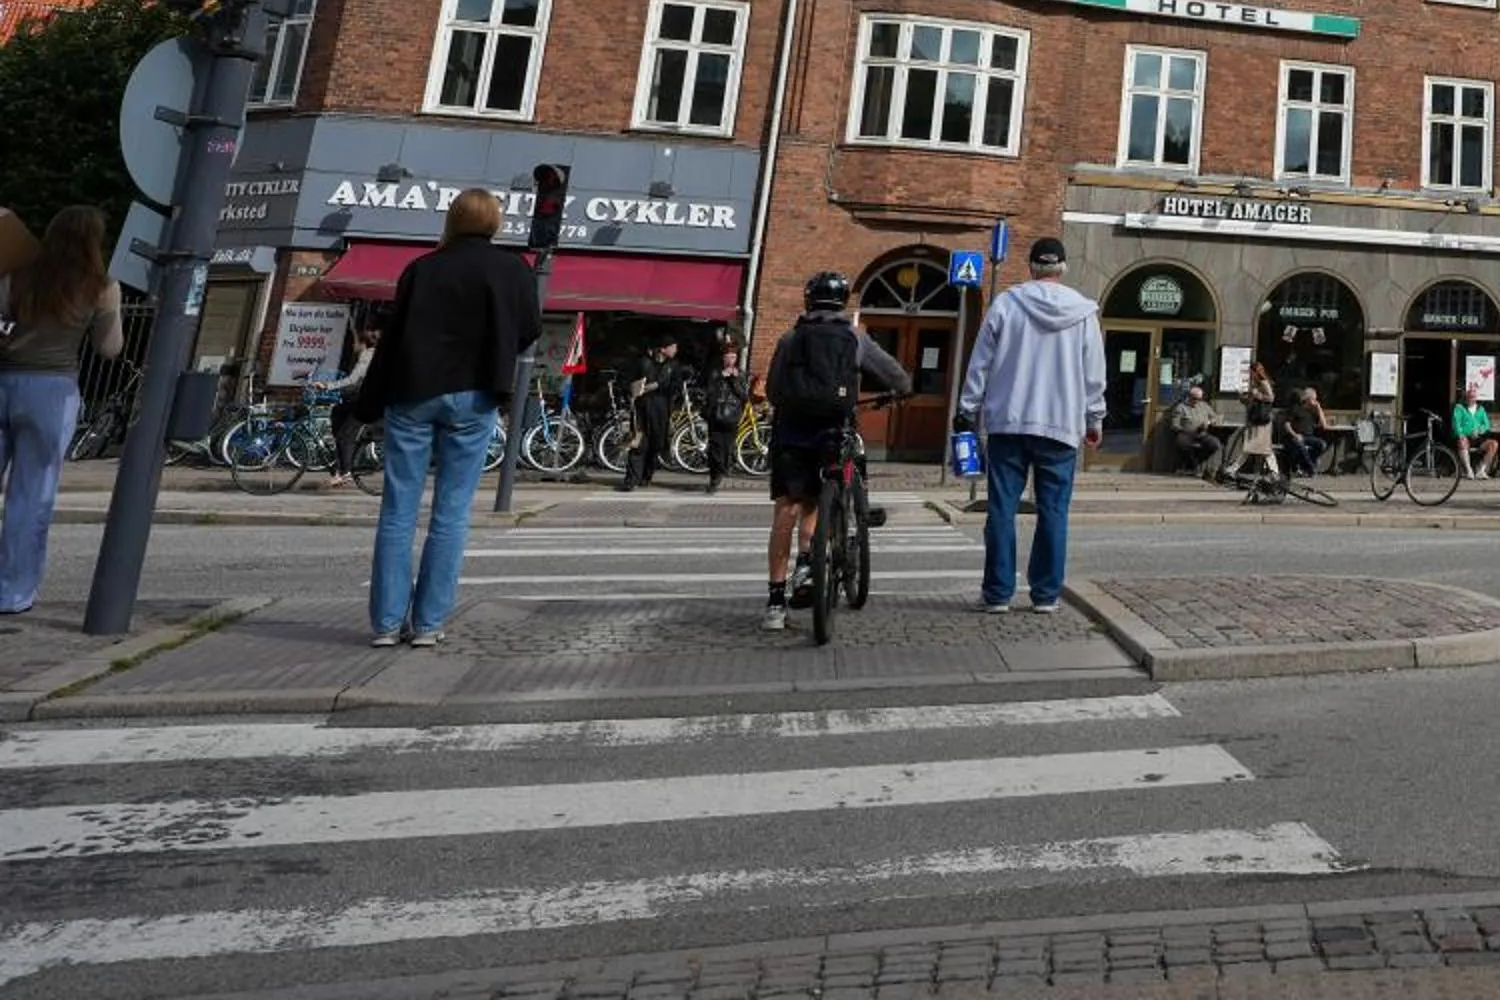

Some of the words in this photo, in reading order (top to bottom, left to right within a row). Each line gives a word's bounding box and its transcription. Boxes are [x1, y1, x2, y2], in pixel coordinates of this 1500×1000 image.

[247, 180, 299, 196] CYKLER
[219, 202, 268, 221] rksted
[494, 190, 576, 218] IT
[585, 197, 737, 229] CYKLER
[1163, 197, 1228, 218] HOTEL
[1231, 201, 1313, 223] AMAGER
